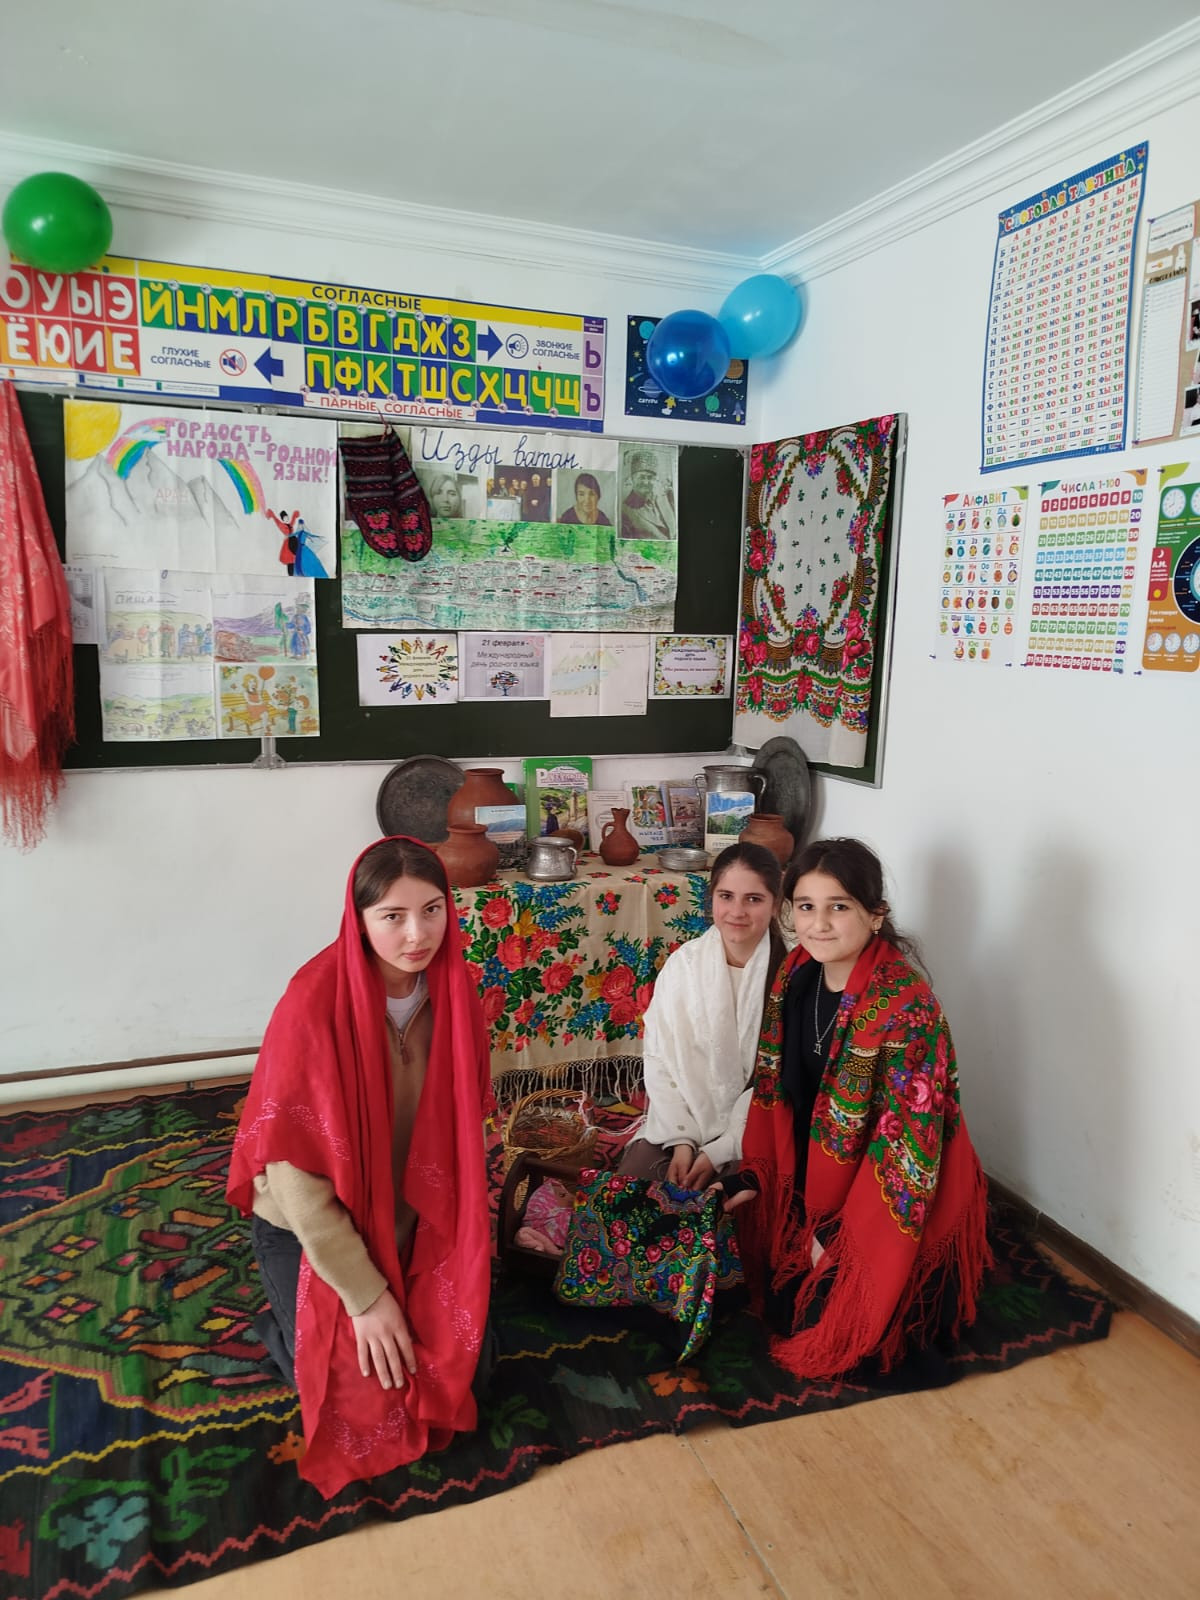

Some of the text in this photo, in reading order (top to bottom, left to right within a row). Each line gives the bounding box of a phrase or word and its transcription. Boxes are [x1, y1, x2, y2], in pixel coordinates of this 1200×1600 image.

[1005, 159, 1136, 231] СЛОГОВАЯ ТАБЛИЦА
[1, 269, 133, 320] О У Ы Э
[312, 286, 422, 311] СОГЛАСНЫЕ
[142, 282, 470, 357] Й Н М Л Р Б В Г Д Ж З
[7, 316, 135, 370] Ё Ю И Е
[161, 346, 200, 358] ГЛУХИЕ
[536, 339, 573, 351] ЗВОНКИЕ
[585, 340, 601, 368] Ь
[150, 355, 211, 369] СОГЛАСНЫЕ
[532, 348, 581, 361] СОГЛАСНЫЕ
[307, 353, 579, 413] П Ф К Т Ш С Х Ц Ч Щ
[320, 396, 463, 418] ПАРНЫЕ СОГЛАСНЫЕ
[584, 383, 601, 411] Ъ
[165, 421, 272, 443] ГОРДОСТЬ
[167, 440, 249, 460] НАРОДА
[273, 462, 329, 483] ЯЗЫК!
[1061, 478, 1120, 493] ЧИСЛА 1-100
[963, 492, 1007, 507] АЛФАВИТ
